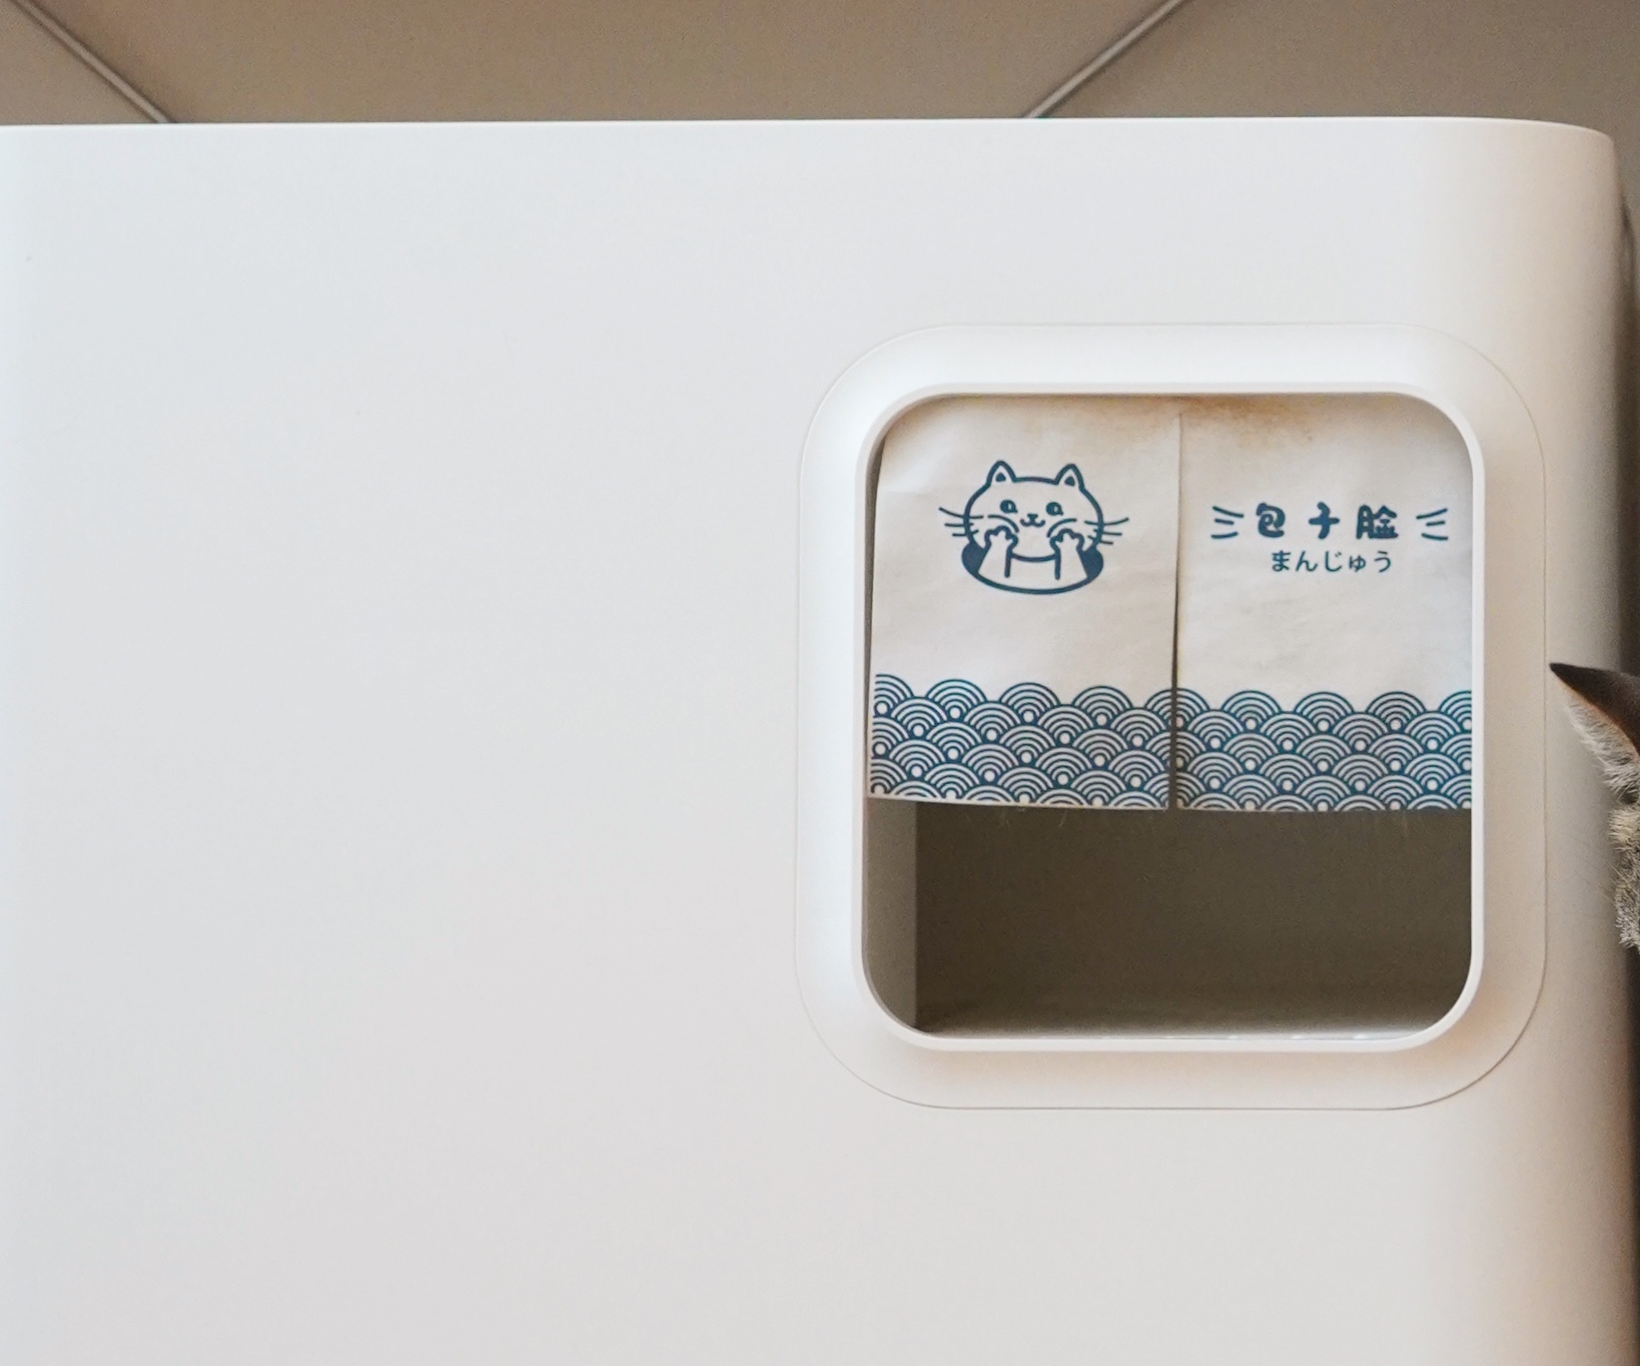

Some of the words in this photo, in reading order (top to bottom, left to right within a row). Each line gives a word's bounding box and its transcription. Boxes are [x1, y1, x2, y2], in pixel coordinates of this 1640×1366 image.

[1255, 501, 1399, 540] 包子脸
[1271, 550, 1392, 573] まんじゅう
